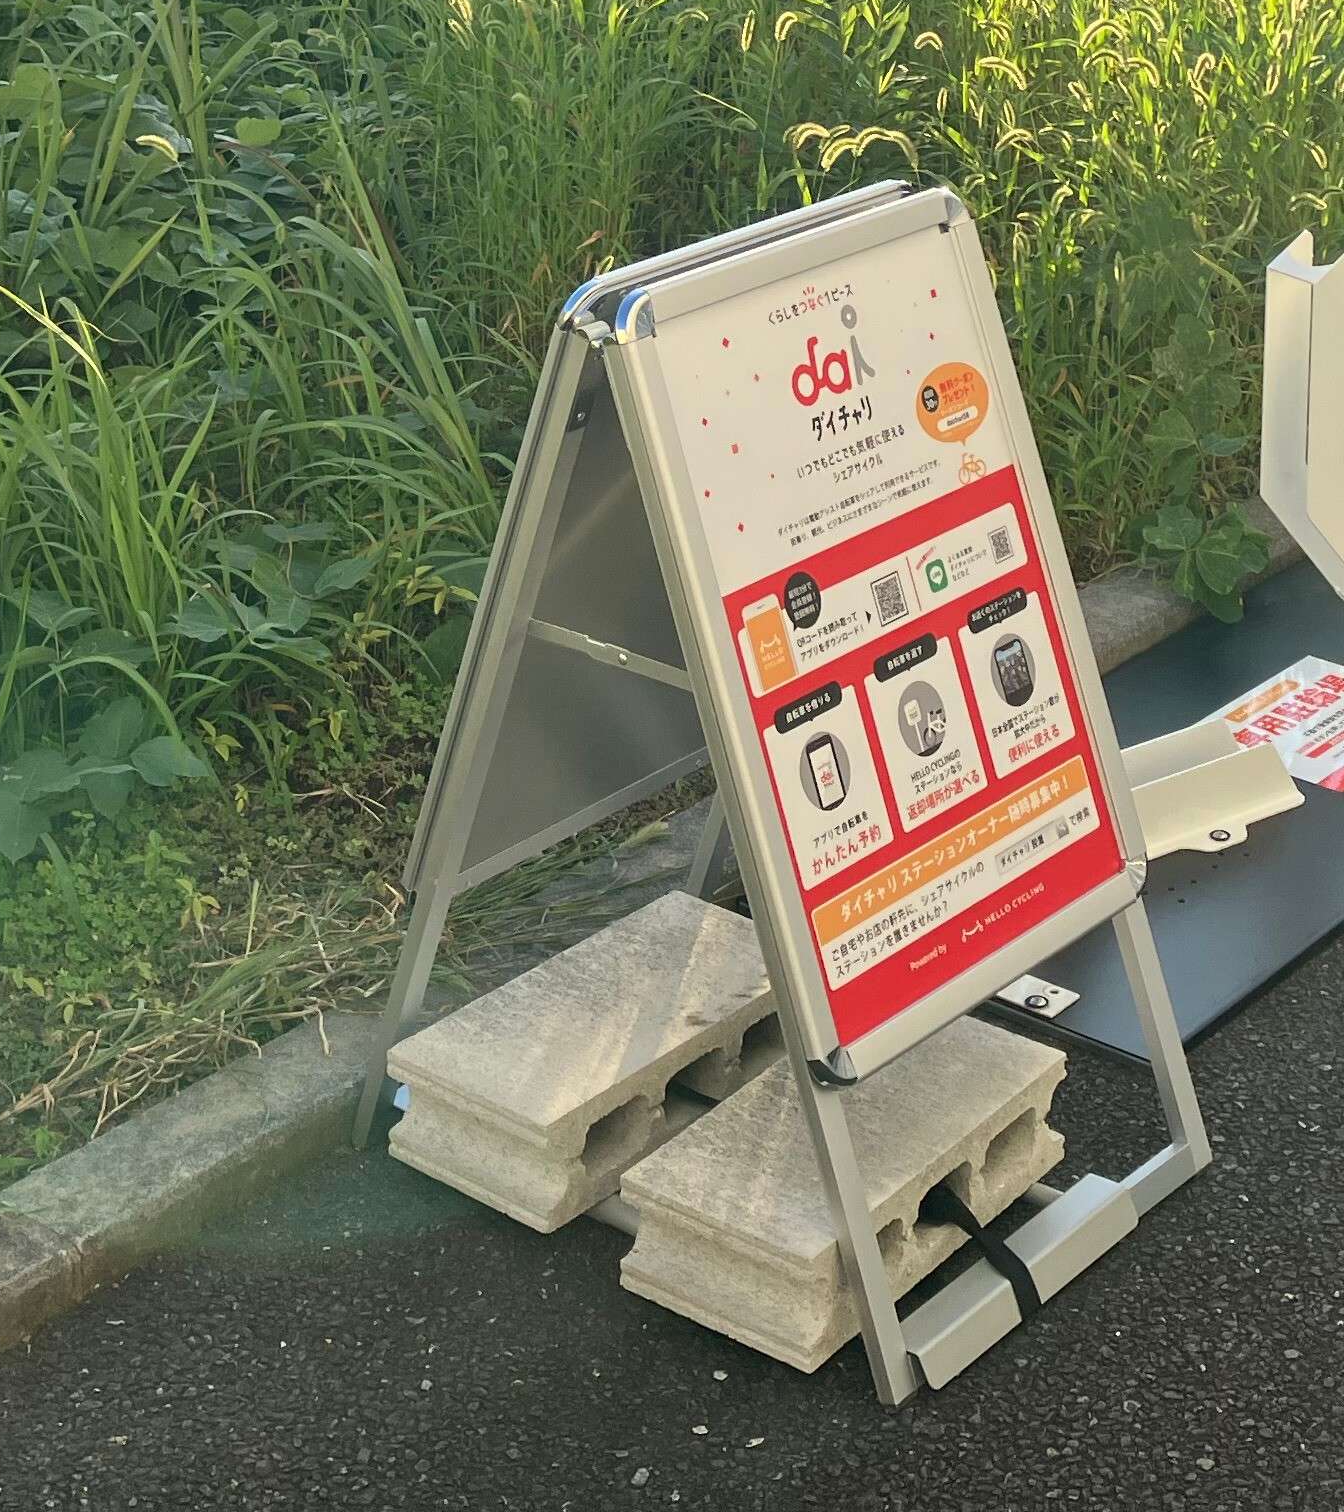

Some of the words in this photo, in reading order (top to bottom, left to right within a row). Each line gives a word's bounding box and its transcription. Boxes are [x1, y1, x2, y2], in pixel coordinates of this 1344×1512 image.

[791, 304, 876, 407] dai
[812, 396, 872, 441] ダイチャリ
[797, 424, 905, 479] いつでもどこでも気軽に使える
[833, 453, 883, 483] シェアサイクル
[887, 645, 923, 672] 自転車を返す
[785, 692, 831, 724] 自転車を借りる
[1008, 723, 1061, 762] 便利に使える
[910, 765, 930, 782] HELLO
[914, 762, 963, 795] ステーションなら
[907, 769, 980, 821] 返却場所が選べる
[812, 810, 869, 848] アプリで自転車を
[812, 824, 881, 876] かんたん予約
[1001, 845, 1030, 868] ダイチャリ
[831, 861, 985, 963] ご自宅やお店の軒先に、シェアサイクルの
[840, 874, 898, 923] ダイチャリ
[983, 903, 1011, 925] HELLO
[1011, 882, 1045, 909] CYCLING
[836, 900, 948, 979] ステーションを置きませんか？
[909, 947, 937, 971] Powered
[936, 943, 948, 956] by
